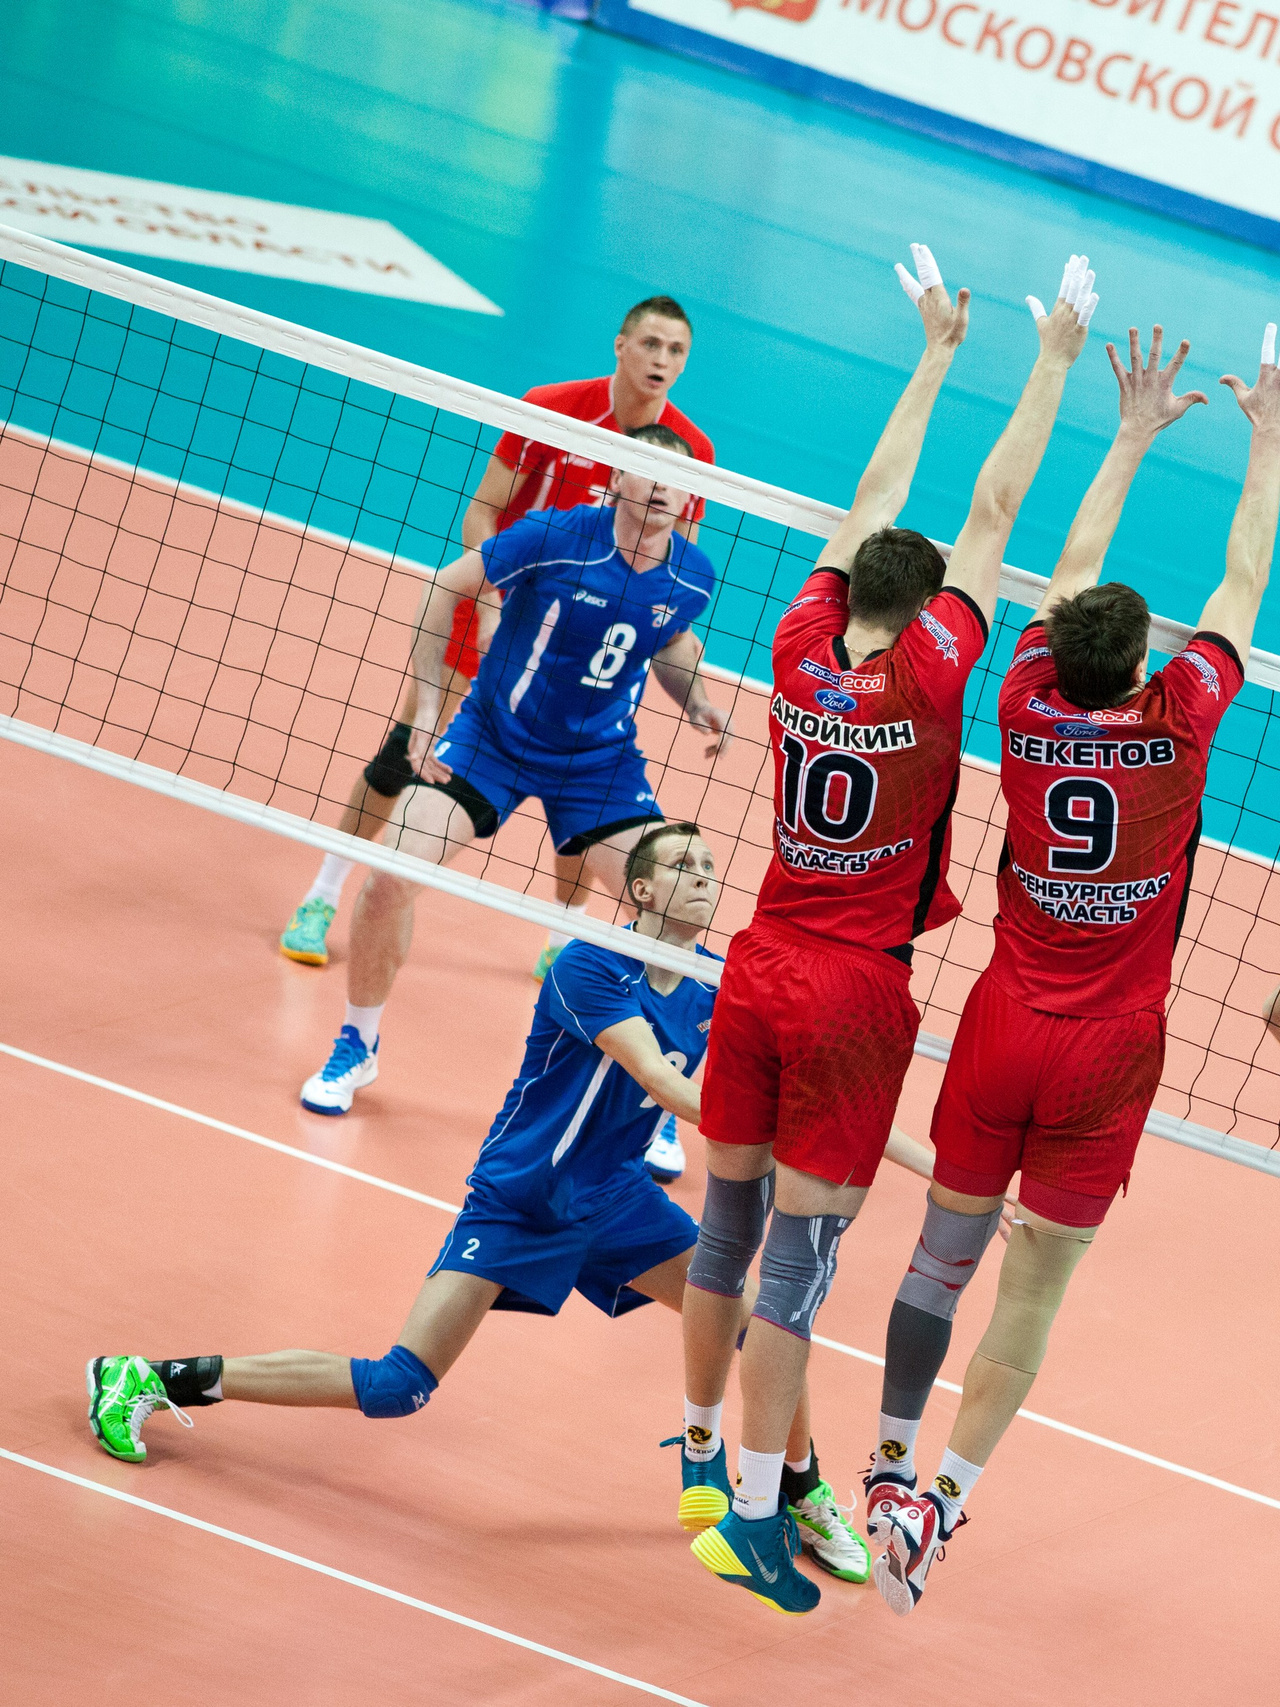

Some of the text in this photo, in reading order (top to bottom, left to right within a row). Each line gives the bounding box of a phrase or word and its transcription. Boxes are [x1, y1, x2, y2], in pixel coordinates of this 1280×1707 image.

[588, 623, 637, 680] 8
[821, 692, 848, 710] Ford
[1008, 728, 1175, 769] БЕКЕТОВ
[1062, 723, 1100, 737] Ford
[780, 730, 880, 844] 10
[1044, 776, 1119, 874] 9
[1012, 862, 1171, 904] РЕНБУРГСКАЯ
[461, 1237, 481, 1260] 2
